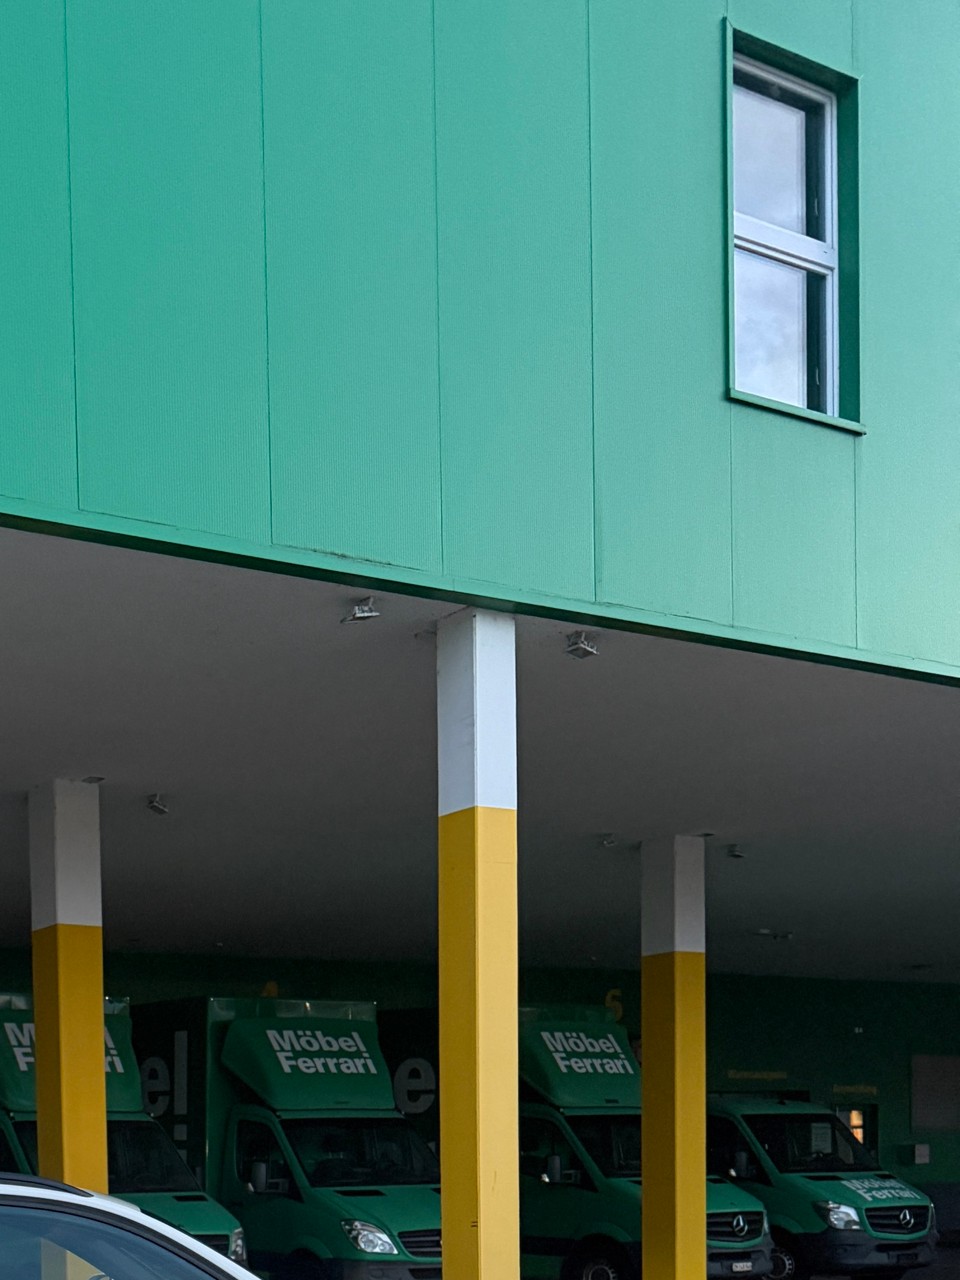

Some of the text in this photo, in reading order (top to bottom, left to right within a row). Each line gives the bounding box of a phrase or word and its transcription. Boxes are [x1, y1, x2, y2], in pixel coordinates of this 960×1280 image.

[266, 1029, 367, 1052] Möbel
[540, 1031, 623, 1054] Möbel
[275, 1051, 377, 1075] Ferrari
[552, 1052, 635, 1075] Ferrari
[856, 1189, 922, 1202] Ferrari
